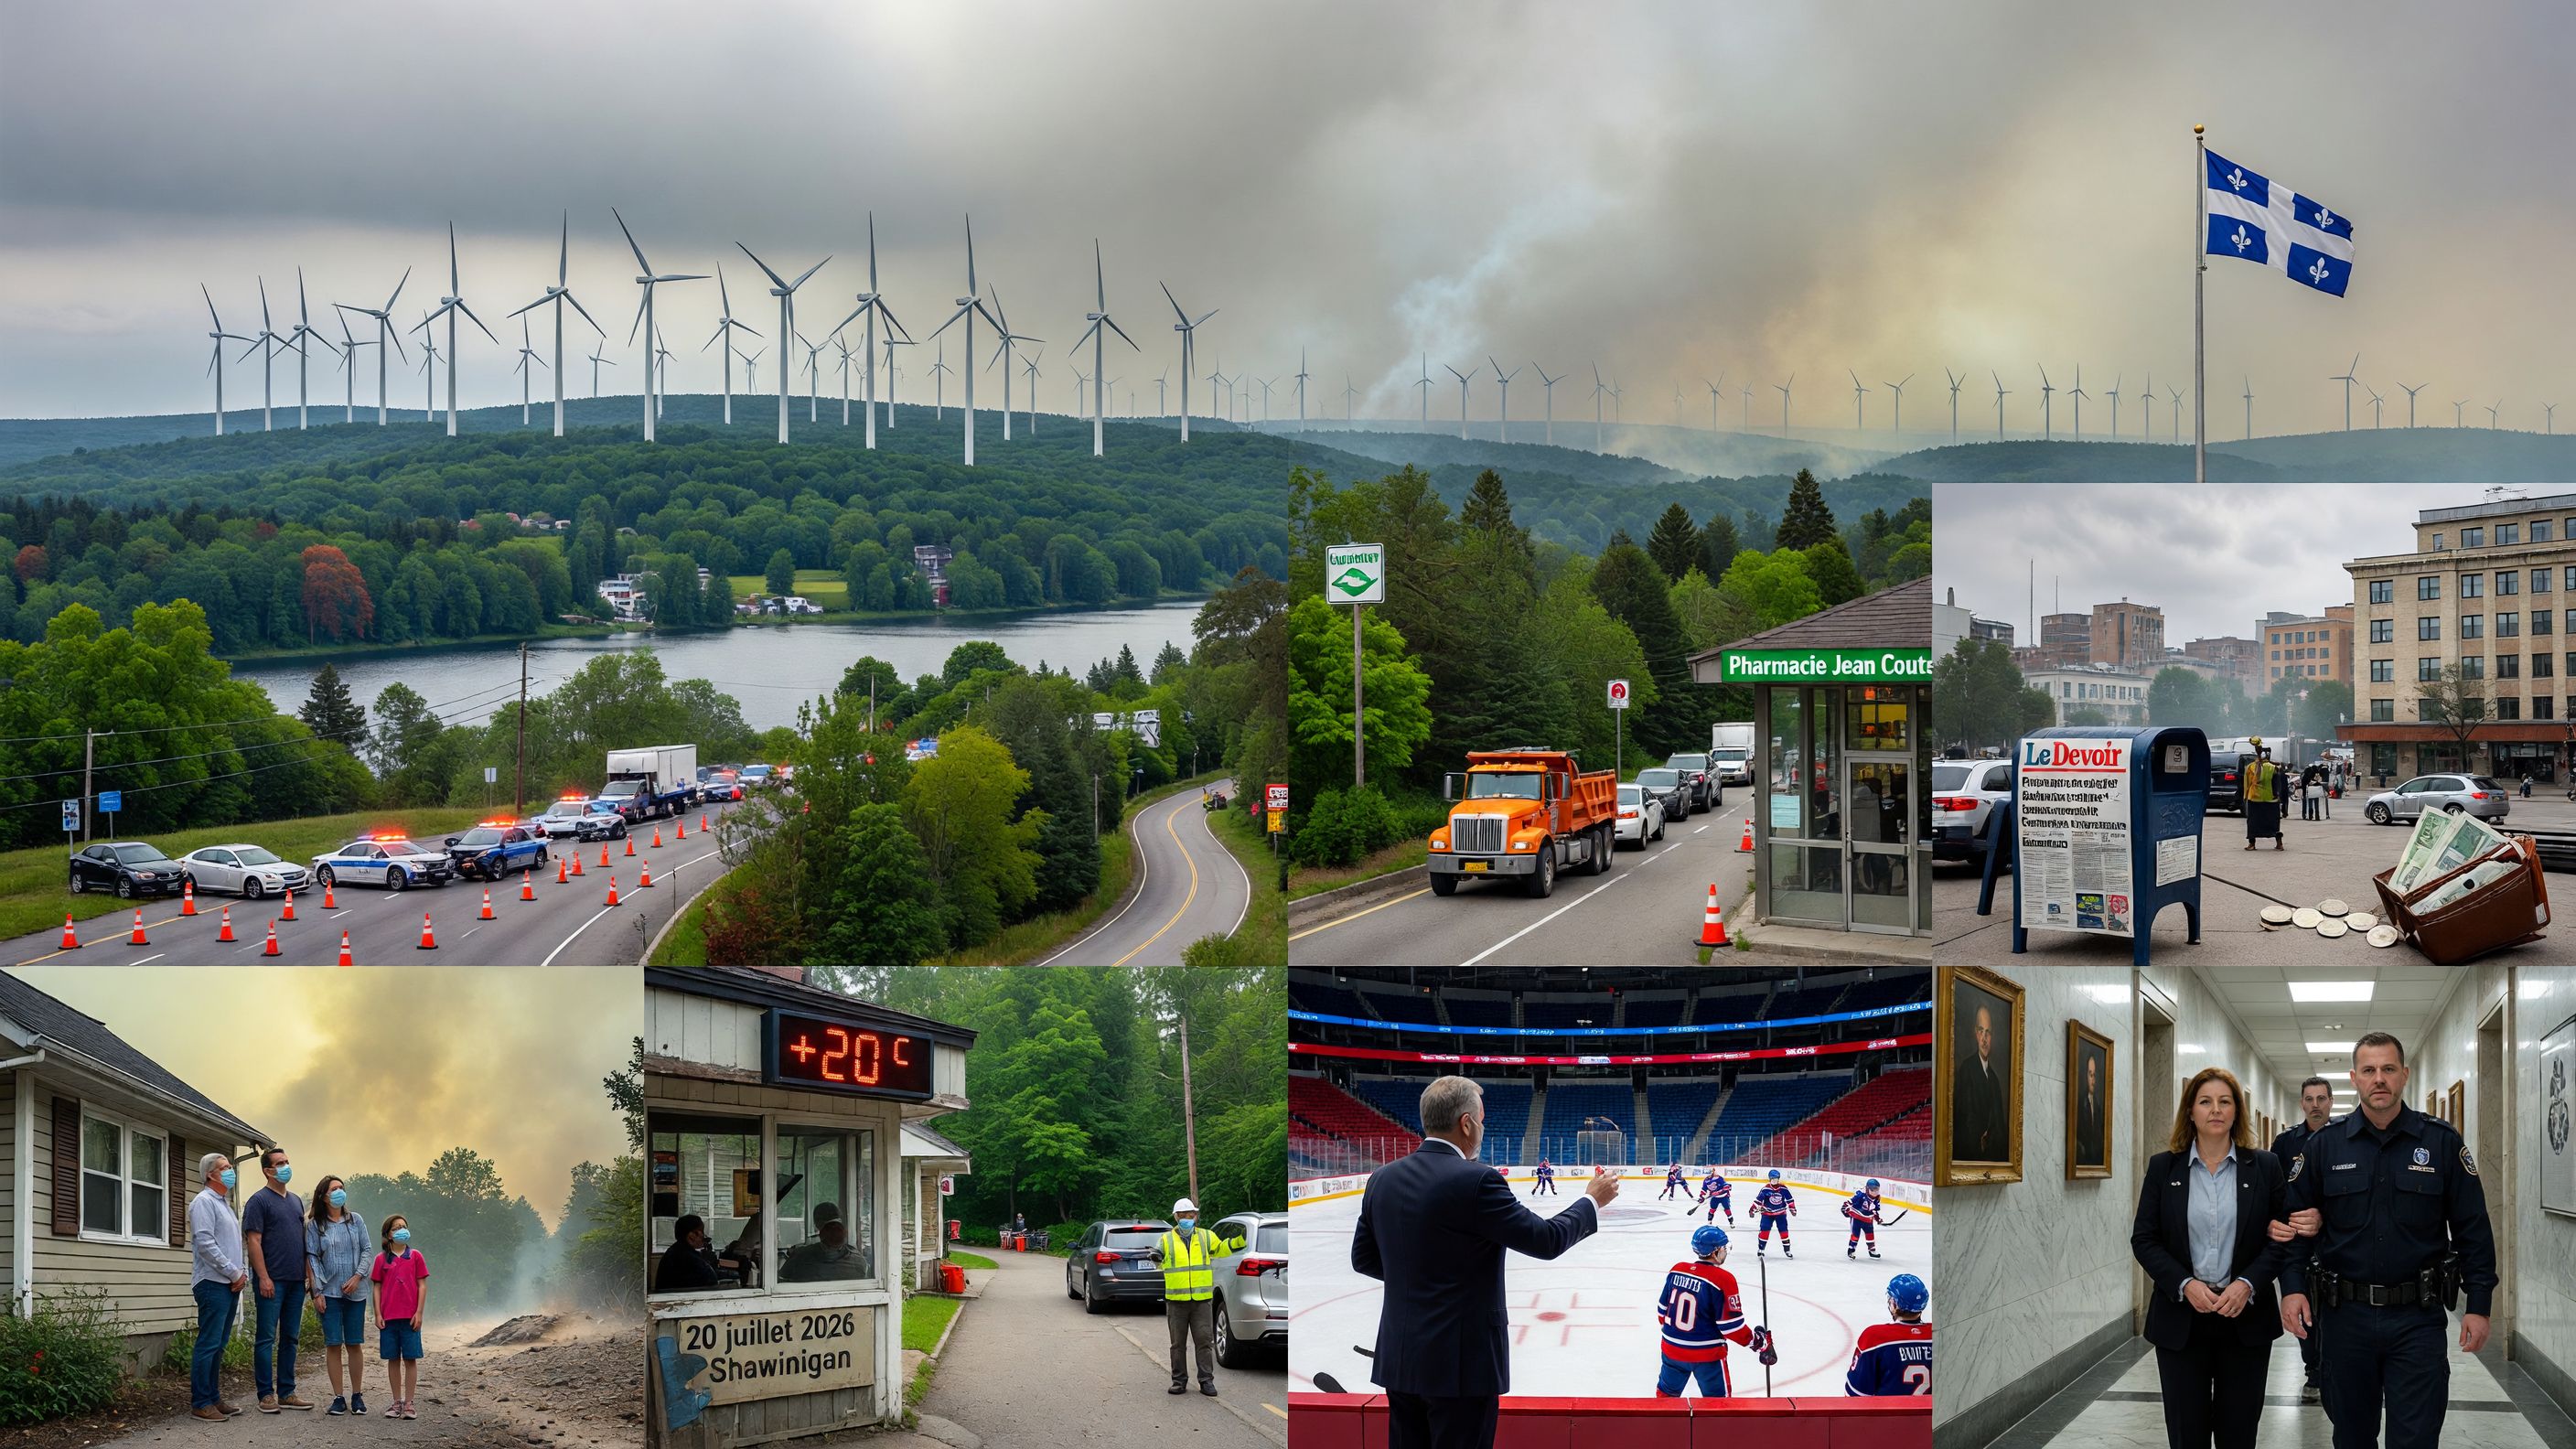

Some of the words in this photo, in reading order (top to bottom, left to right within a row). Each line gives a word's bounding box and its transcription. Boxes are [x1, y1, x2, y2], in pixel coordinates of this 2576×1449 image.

[1729, 655, 1828, 676] Pharmacie
[1832, 654, 1876, 676] Jean
[2024, 742, 2051, 766] Le
[2051, 740, 2122, 767] Devoir
[789, 1028, 879, 1084] +20
[686, 1324, 717, 1351] 20
[724, 1318, 793, 1355] juillet
[800, 1312, 855, 1341] 2026
[709, 1348, 852, 1383] Shawinigan
